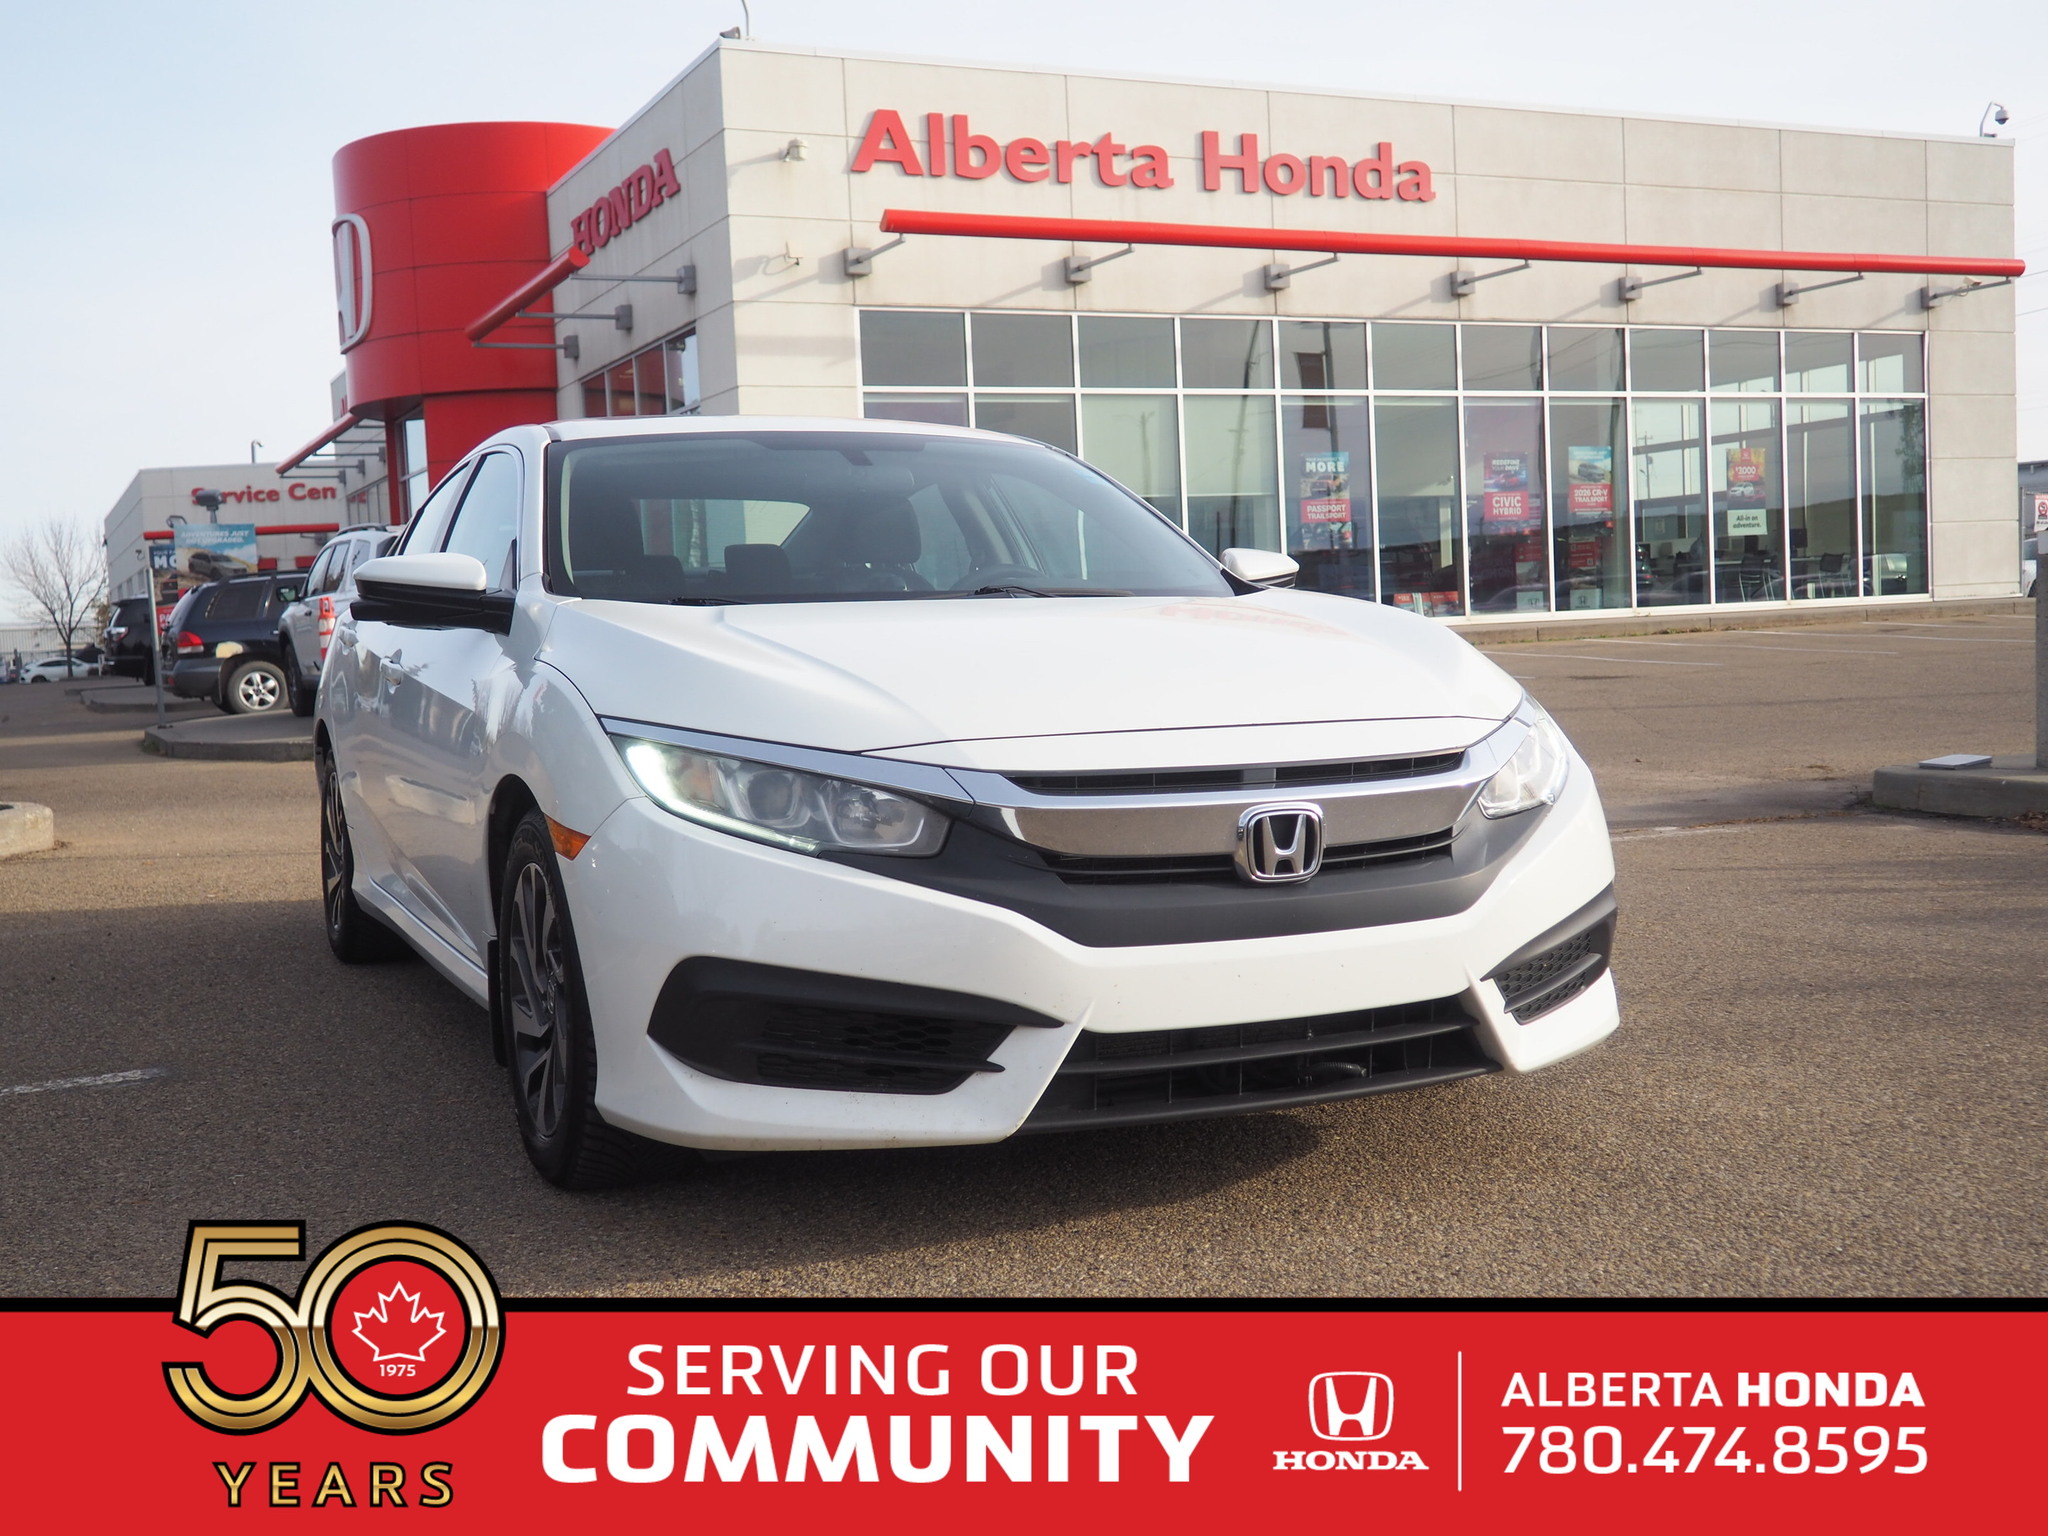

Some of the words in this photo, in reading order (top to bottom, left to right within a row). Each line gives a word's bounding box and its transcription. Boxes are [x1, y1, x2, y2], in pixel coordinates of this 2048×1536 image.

[851, 109, 1175, 189] Alberta
[1202, 131, 1436, 202] Honda
[571, 148, 681, 257] HONDA
[1306, 461, 1345, 473] MORE
[1492, 497, 1522, 507] CIVIC
[1307, 504, 1347, 513] PASSPORT
[1308, 512, 1347, 520] TRAILSPORT
[1733, 521, 1762, 529] adventure.
[230, 529, 250, 537] JUST
